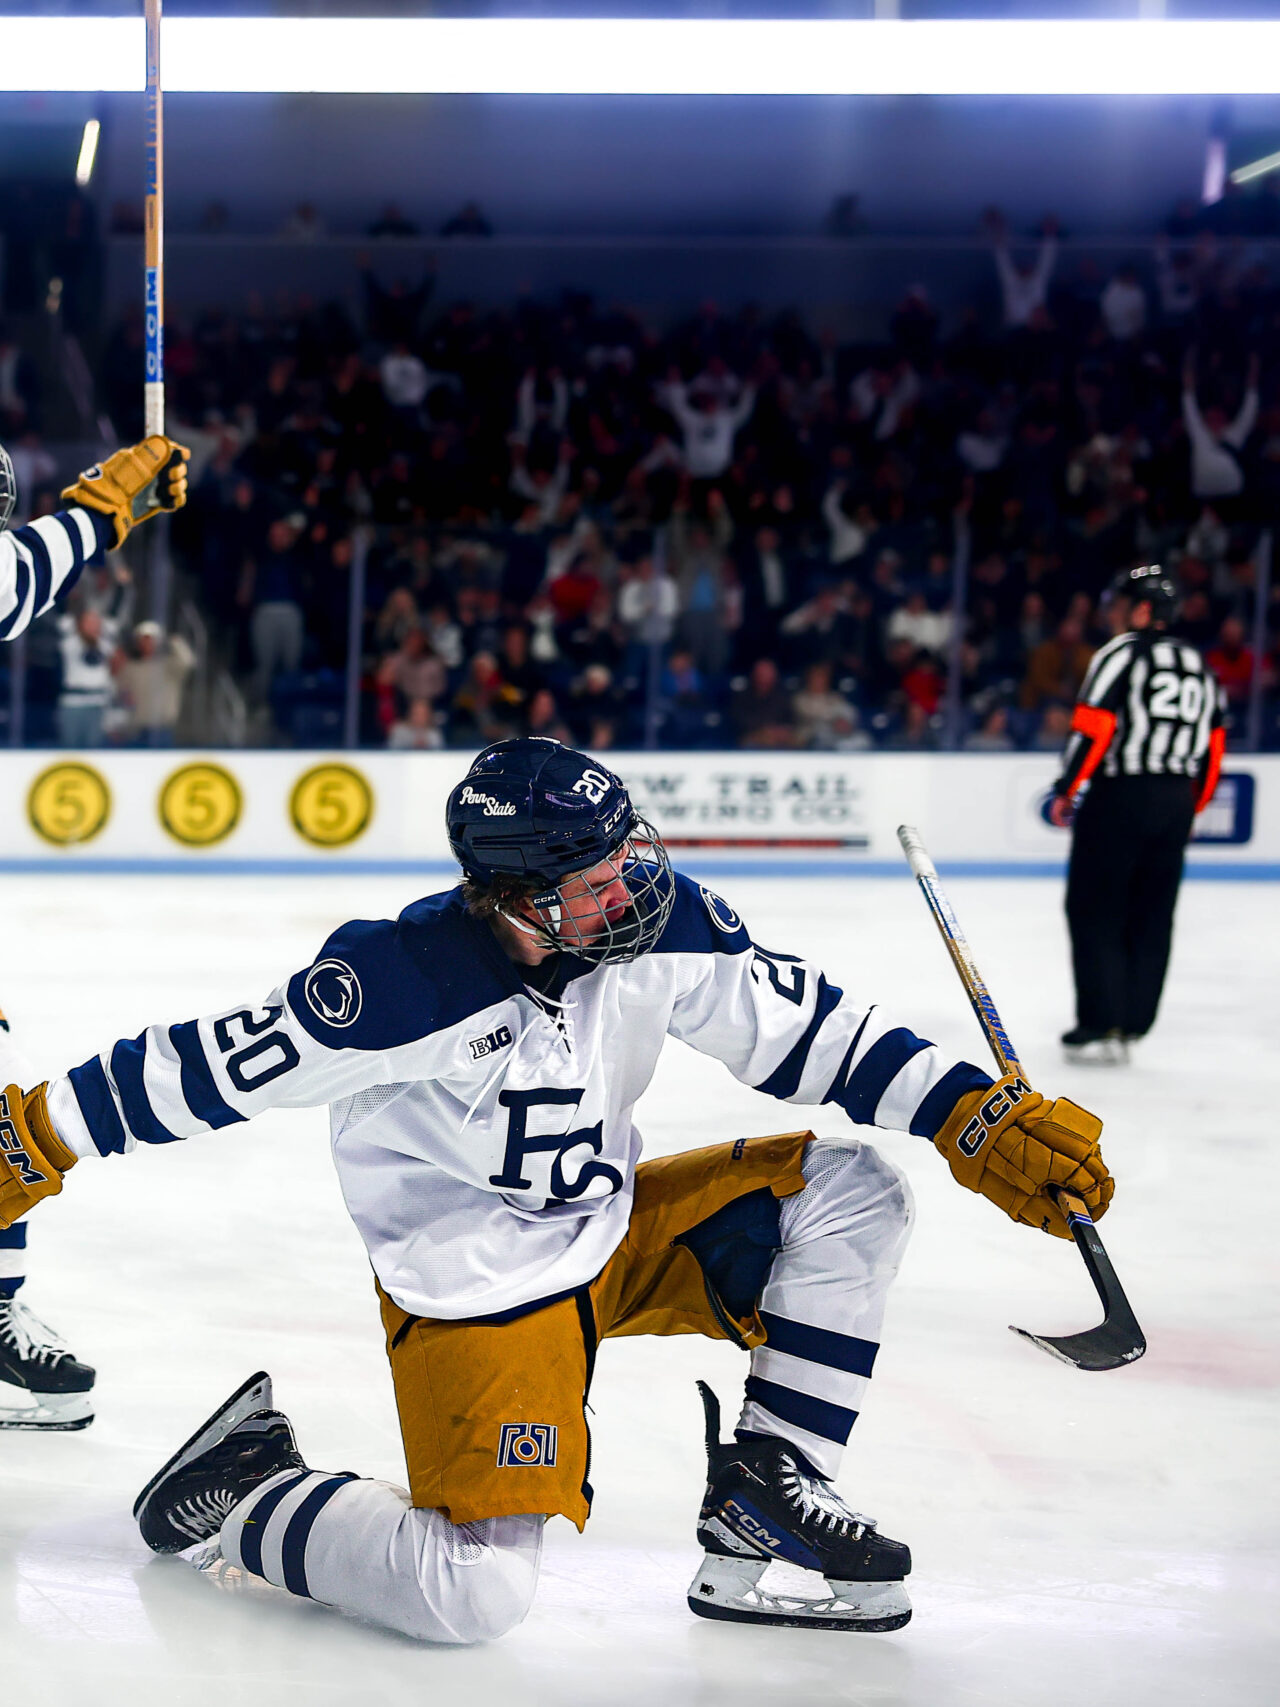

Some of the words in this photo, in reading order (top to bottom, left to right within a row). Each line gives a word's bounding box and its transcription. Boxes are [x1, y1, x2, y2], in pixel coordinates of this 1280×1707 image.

[145, 268, 158, 377] CCM
[1148, 671, 1203, 724] 20
[51, 778, 87, 831] 5
[182, 778, 218, 831] 5
[314, 778, 350, 831] 5
[459, 786, 488, 806] Penn
[483, 797, 517, 817] State
[572, 769, 611, 806] 20
[710, 772, 859, 798] TRAIL
[533, 895, 557, 905] CCM
[214, 1004, 301, 1093] 20
[956, 1076, 1035, 1158] CCM
[723, 1499, 782, 1548] CCM
